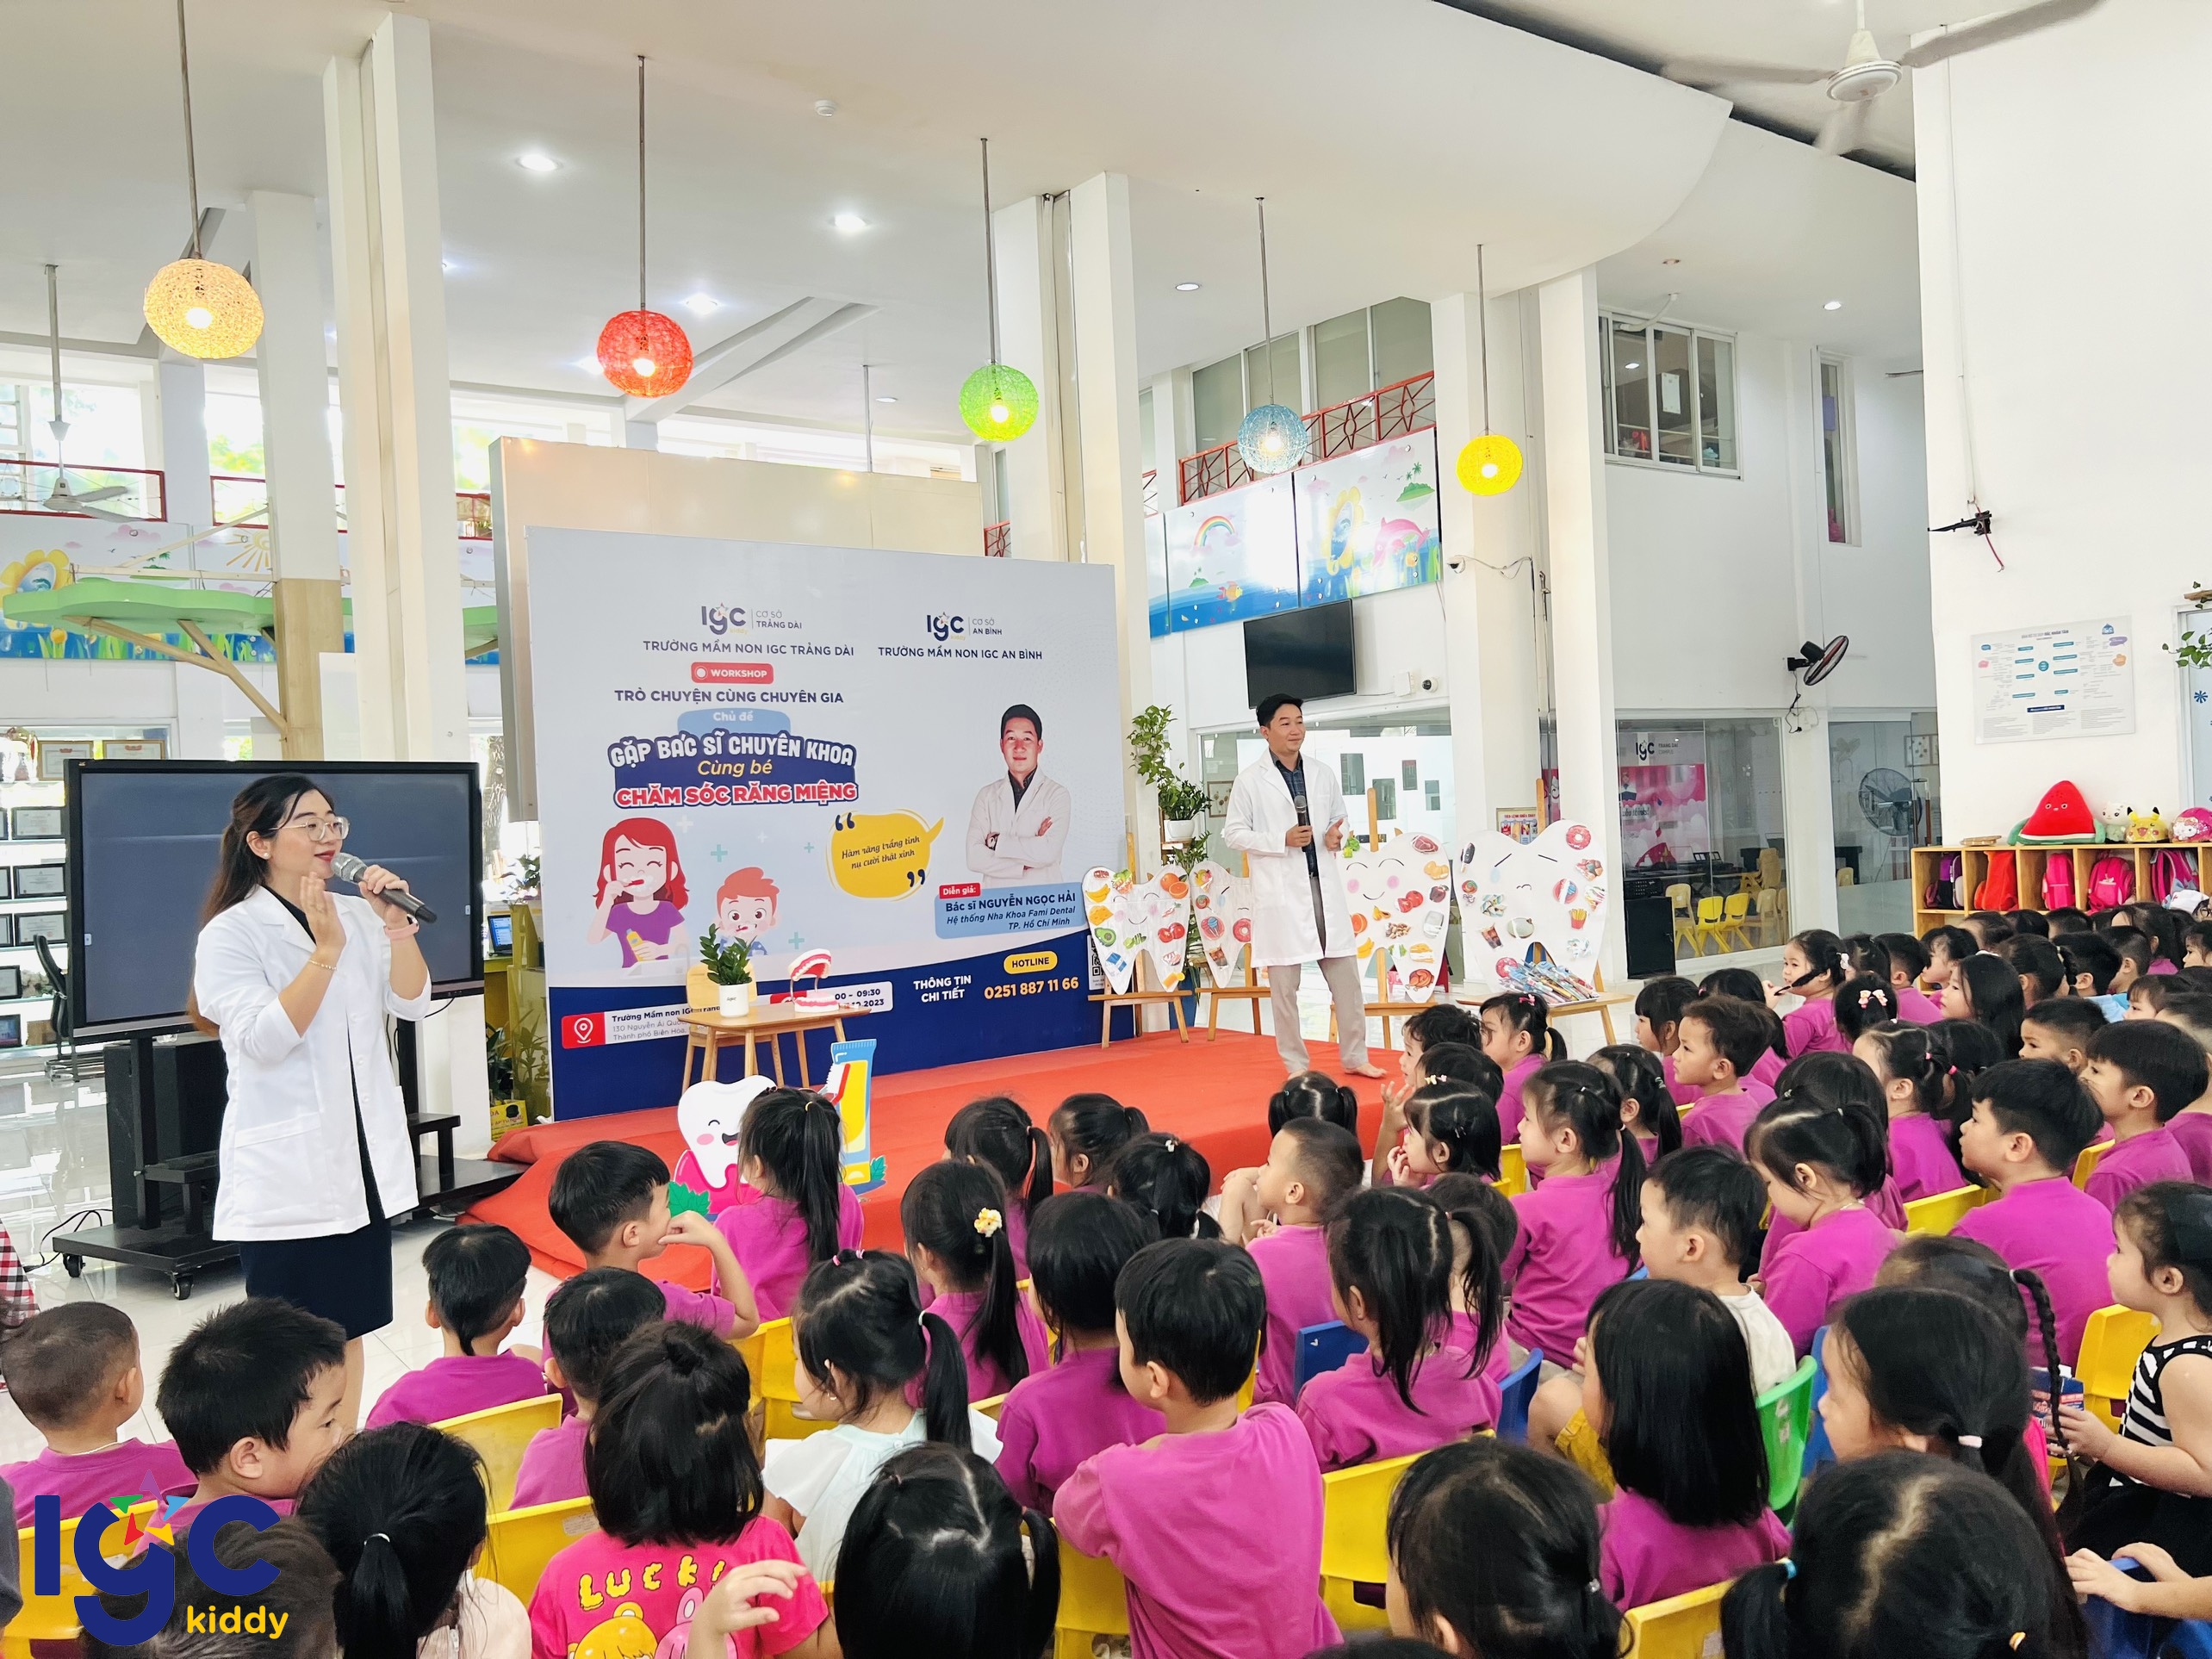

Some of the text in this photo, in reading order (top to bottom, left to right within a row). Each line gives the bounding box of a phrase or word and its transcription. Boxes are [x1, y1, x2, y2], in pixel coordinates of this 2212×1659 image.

[756, 610, 768, 618] CƠ
[756, 618, 802, 629] TRẢNG DÀI
[643, 639, 698, 652] TRƯỜNG
[736, 644, 763, 654] NON
[767, 644, 787, 655] IGC
[791, 643, 831, 656] TRẢNG
[836, 644, 854, 656] DÀI
[879, 646, 924, 657] TRƯỜNG
[956, 649, 979, 658] NON
[982, 649, 998, 658] IGC
[1019, 649, 1042, 660] BÌNH
[711, 668, 767, 678] WORKSHOP
[615, 687, 844, 705] TRÒ CHUYỆN CÙNG CHUYÊN GIA
[713, 711, 736, 722] Chủ
[611, 730, 854, 768] GẶP BÁC SĨ CHUYÊN KHOA
[698, 760, 772, 777] Cùng bé
[616, 780, 858, 806] CHĂM SÓC RĂNG MIỆNG
[842, 848, 860, 860] Hàm
[943, 886, 960, 896] Diễn
[946, 890, 1076, 911] Bác sĩ NGUYỄN NGỌC HẢI
[947, 916, 958, 925] Hệ
[960, 913, 985, 924] thống
[1006, 910, 1026, 919] Khoa
[1028, 908, 1048, 917] Fami
[1050, 906, 1076, 916] Dental
[1052, 916, 1070, 926] Minh
[1012, 956, 1049, 968] HOTLINE
[913, 974, 972, 990] THÔNG TIN
[984, 984, 1016, 999] 0251
[1020, 980, 1045, 994] 887
[1047, 979, 1059, 991] 11
[1062, 977, 1078, 990] 66
[857, 989, 880, 997] 09:30
[922, 985, 965, 1003] CHI TIẾT
[612, 1013, 641, 1022] Trường
[627, 1022, 655, 1031] Nguyễn
